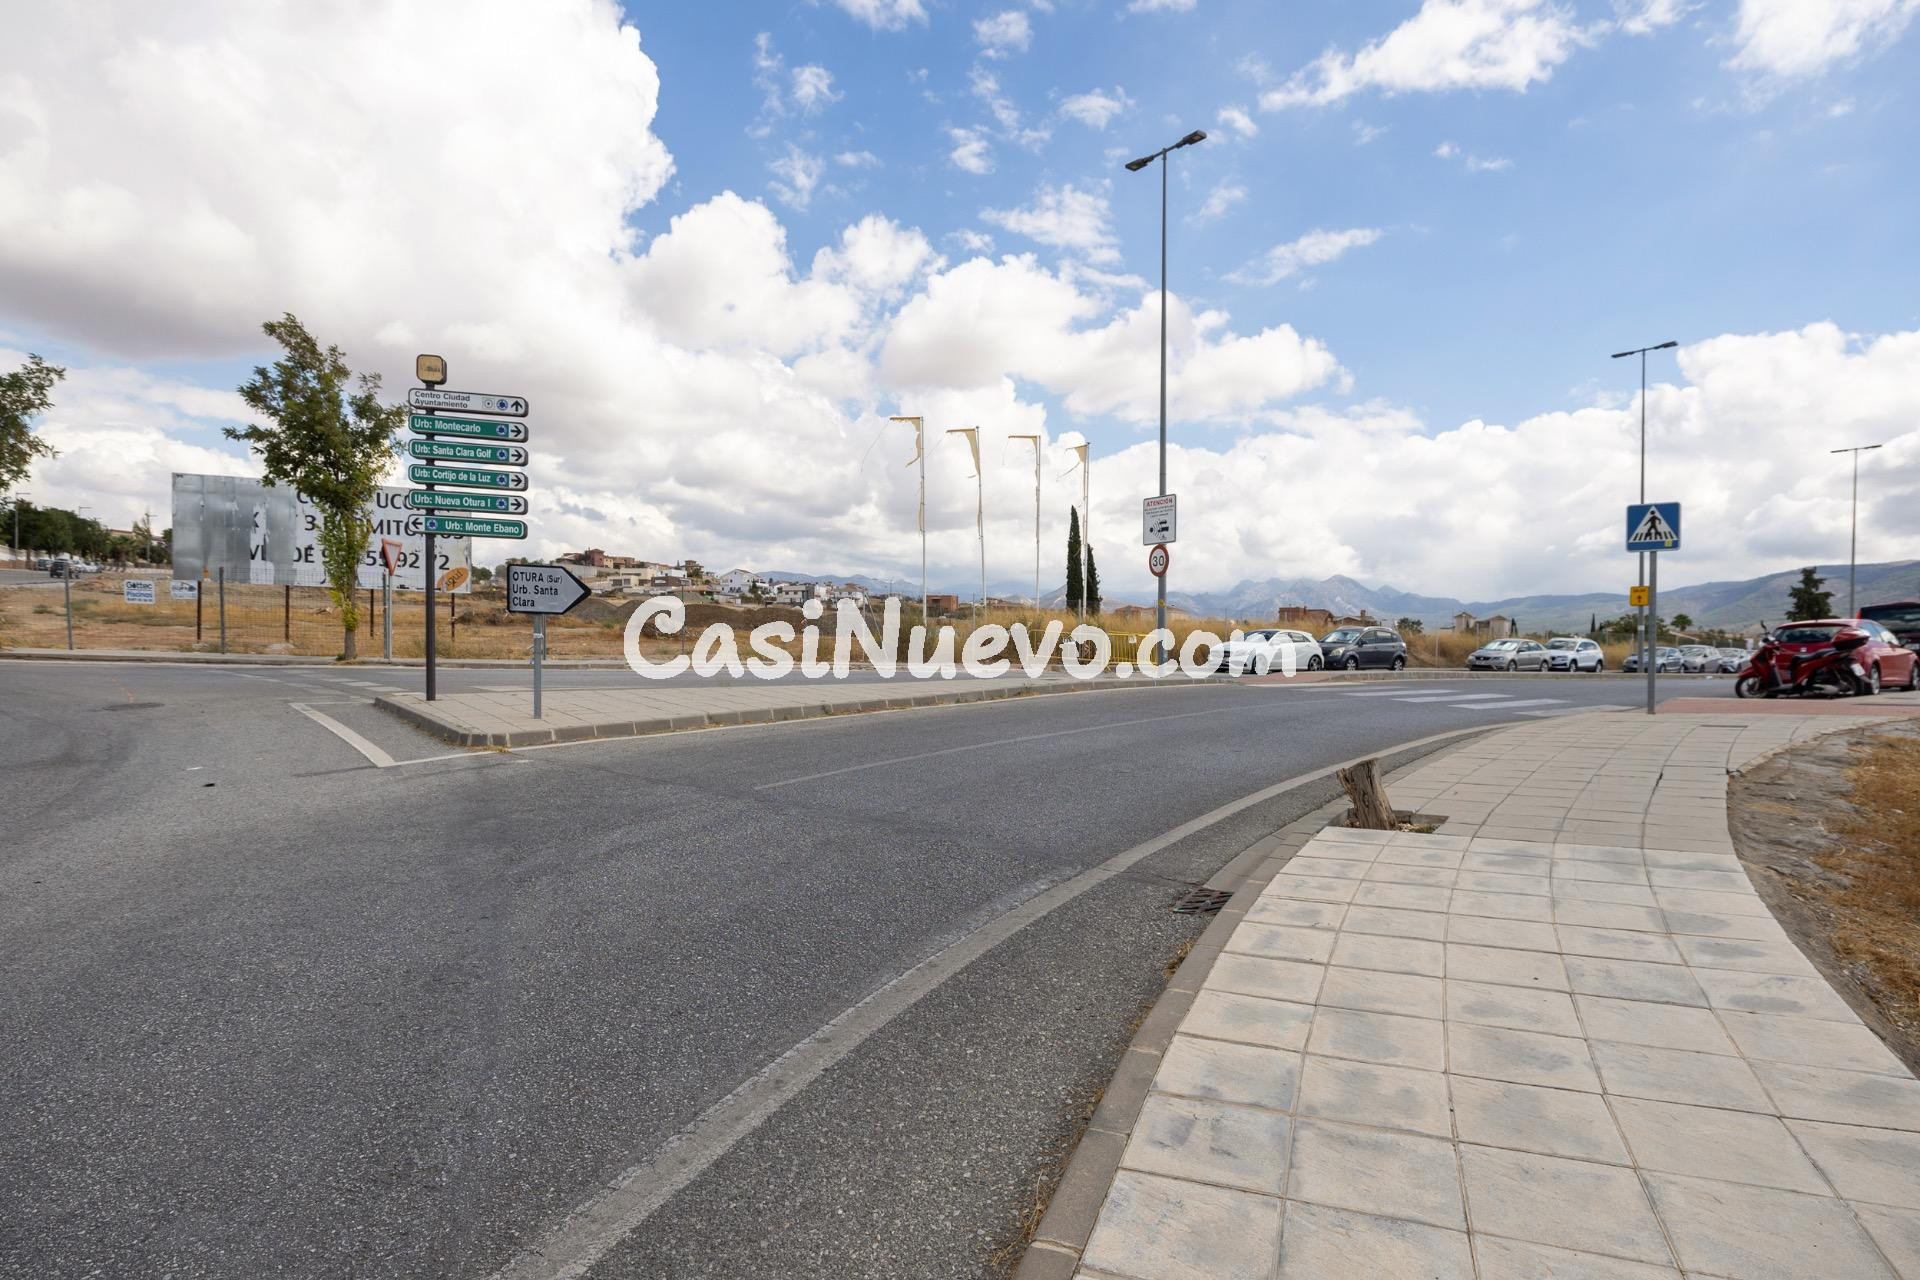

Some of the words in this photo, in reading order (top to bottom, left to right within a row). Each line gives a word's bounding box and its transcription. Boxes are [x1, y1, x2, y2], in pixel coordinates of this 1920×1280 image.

[414, 391, 441, 399] Centro
[443, 393, 470, 401] Ciudad
[414, 398, 468, 408] Ayuntamiento
[414, 419, 432, 428] Urb:
[435, 420, 481, 433] Montecarlo
[414, 444, 430, 453] Urb:
[432, 445, 454, 455] Santa
[455, 447, 475, 457] Clara
[476, 449, 491, 458] Golf
[414, 469, 430, 478] Urb:
[432, 469, 457, 481] Cortijo
[458, 471, 468, 480] de
[469, 473, 476, 481] la
[478, 474, 491, 482] Luz
[414, 494, 432, 504] Urb:
[435, 496, 460, 505] Nueva
[463, 497, 485, 507] Otura
[445, 521, 463, 530] Urb:
[465, 522, 491, 532] Monte
[494, 523, 519, 534] Ebano
[1152, 555, 1165, 567] 30
[512, 571, 544, 582] OTURA
[547, 575, 562, 584] (Sur)
[512, 585, 531, 595] Urb.
[534, 585, 558, 595] Santa
[512, 597, 535, 607] Clara
